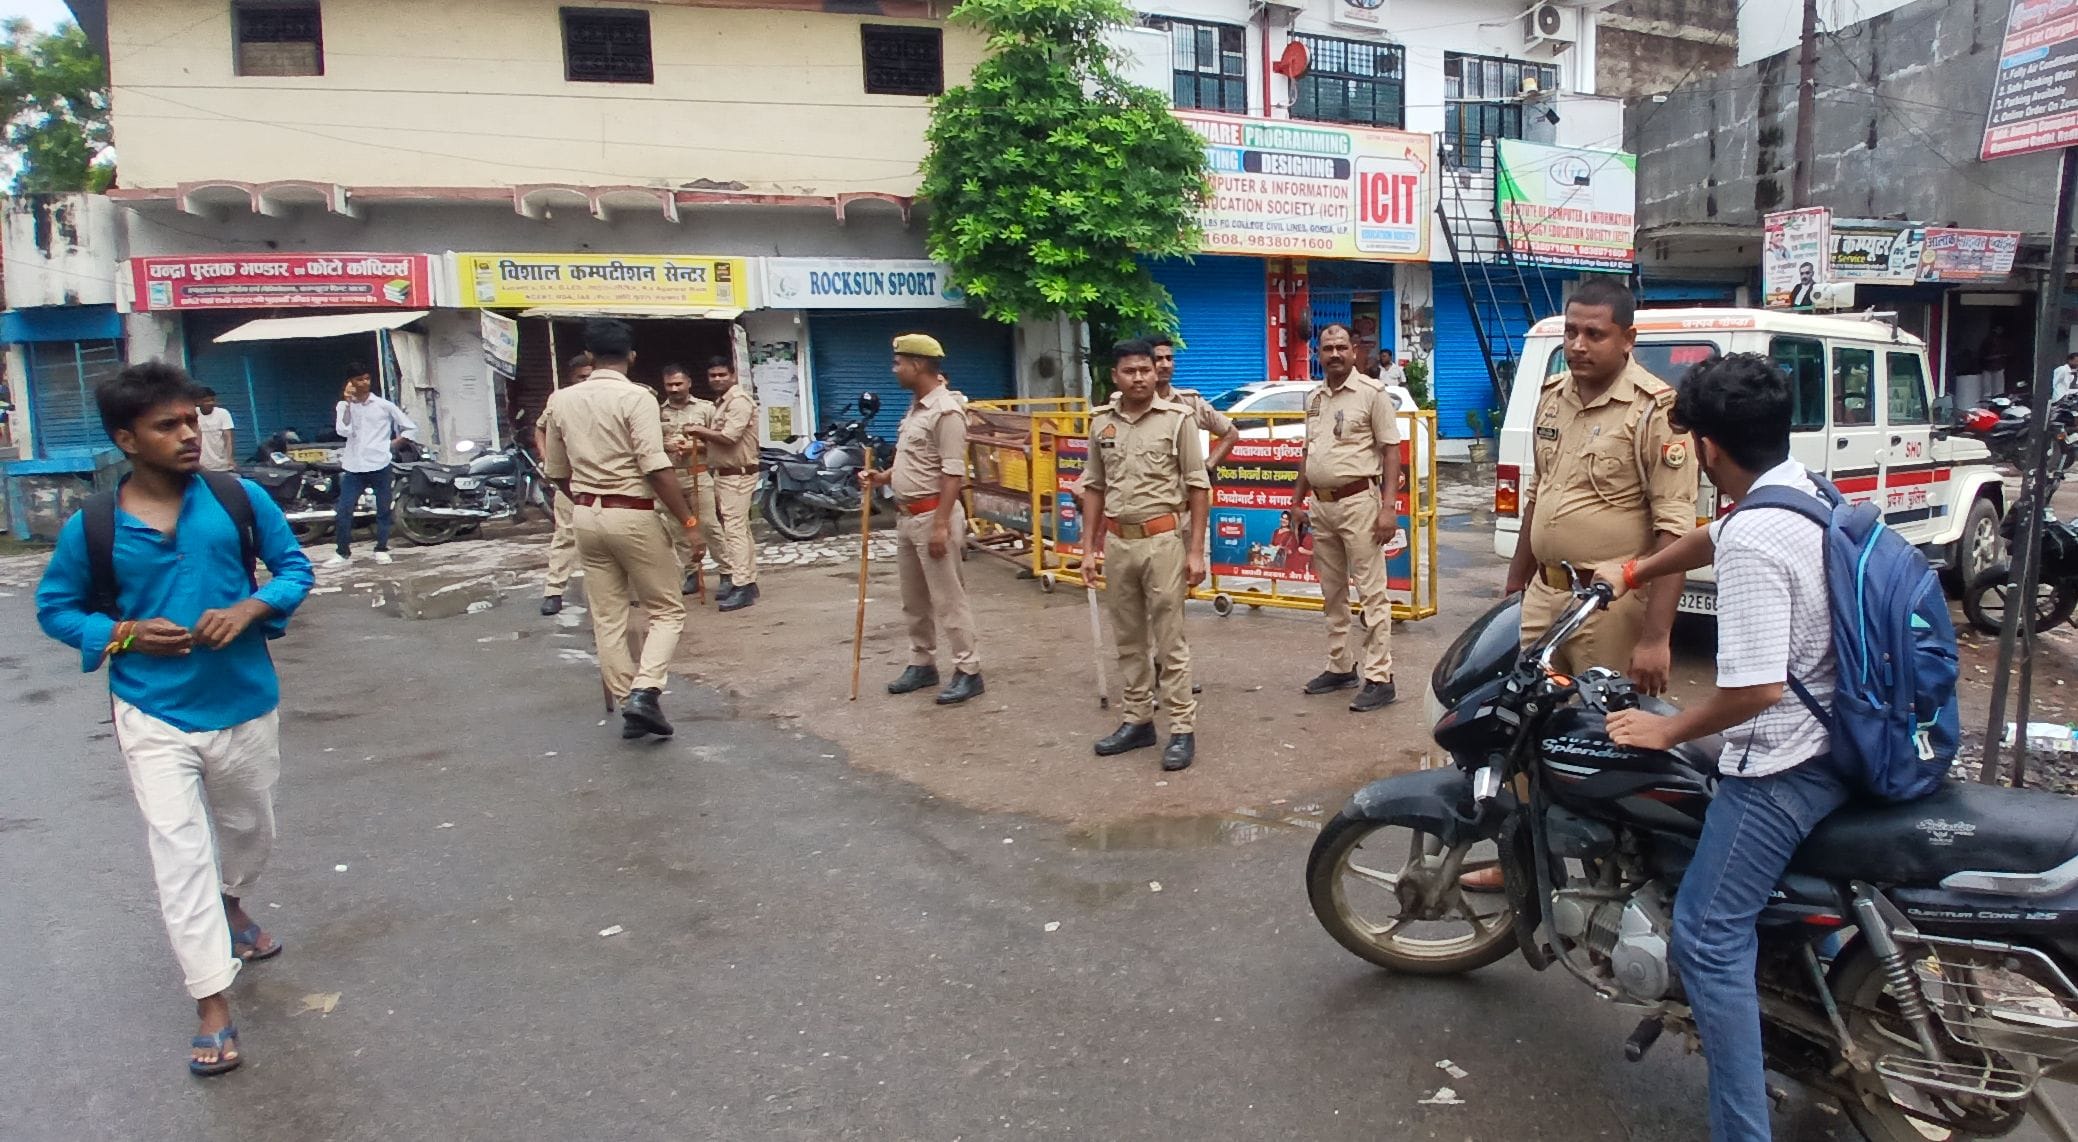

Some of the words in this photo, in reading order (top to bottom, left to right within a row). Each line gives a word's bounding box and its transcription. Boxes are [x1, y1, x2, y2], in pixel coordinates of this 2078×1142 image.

[2023, 76, 2054, 90] Drinking
[1245, 126, 1348, 154] PROGRAMMING
[1207, 149, 1239, 171] TING
[1261, 153, 1335, 178] DESIGNING
[1202, 175, 1256, 194] MPUTER
[1260, 179, 1268, 194] &
[1272, 180, 1349, 200] INFORMATION
[1202, 194, 1263, 213] DUCATION
[1267, 199, 1316, 216] SOCIETY
[1319, 207, 1349, 222] (ICIT)
[1360, 172, 1418, 225] ICIT
[1231, 219, 1264, 231] COLLEGE
[1266, 222, 1285, 232] CIVIL
[1547, 206, 1583, 221] COMPUTER
[1591, 210, 1632, 226] INFORMATION
[1205, 233, 1243, 246] 1608,
[1247, 235, 1334, 250] 9838071600
[1585, 228, 1612, 242] SOCIETY
[189, 263, 236, 281] पुस्तक
[239, 262, 290, 277] भण्डार
[307, 259, 343, 275] फोटो
[499, 259, 561, 281] विशाल
[567, 259, 656, 281] कम्पटीशन
[663, 261, 706, 282] सेन्टर
[810, 271, 886, 296] ROCKSUN
[888, 271, 937, 296] SPORT
[1905, 441, 1921, 458] SHO
[1261, 471, 1272, 480] का
[1256, 491, 1266, 504] से
[1887, 489, 1905, 508] प्रदेश
[1908, 487, 1927, 509] पुलिस
[1542, 738, 1638, 759] Splendor
